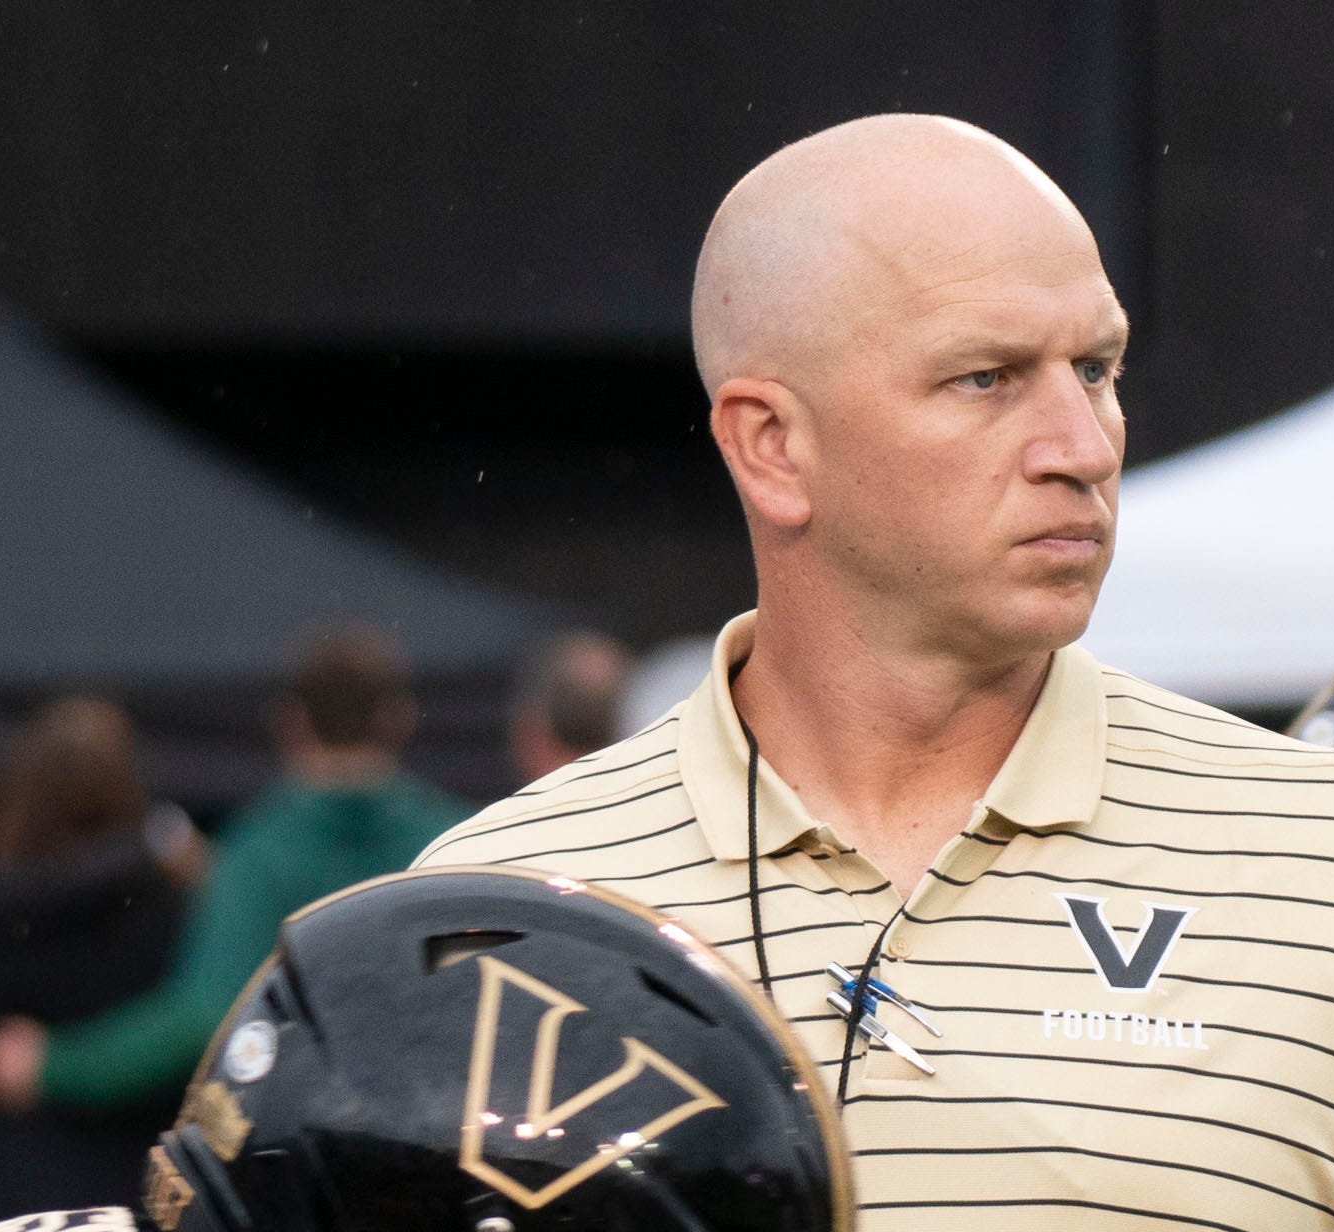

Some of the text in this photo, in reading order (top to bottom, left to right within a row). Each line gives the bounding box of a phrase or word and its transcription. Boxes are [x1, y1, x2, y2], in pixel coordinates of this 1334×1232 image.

[1051, 892, 1200, 993] V
[1042, 1008, 1209, 1051] FOOTBALL
[457, 955, 729, 1210] V
